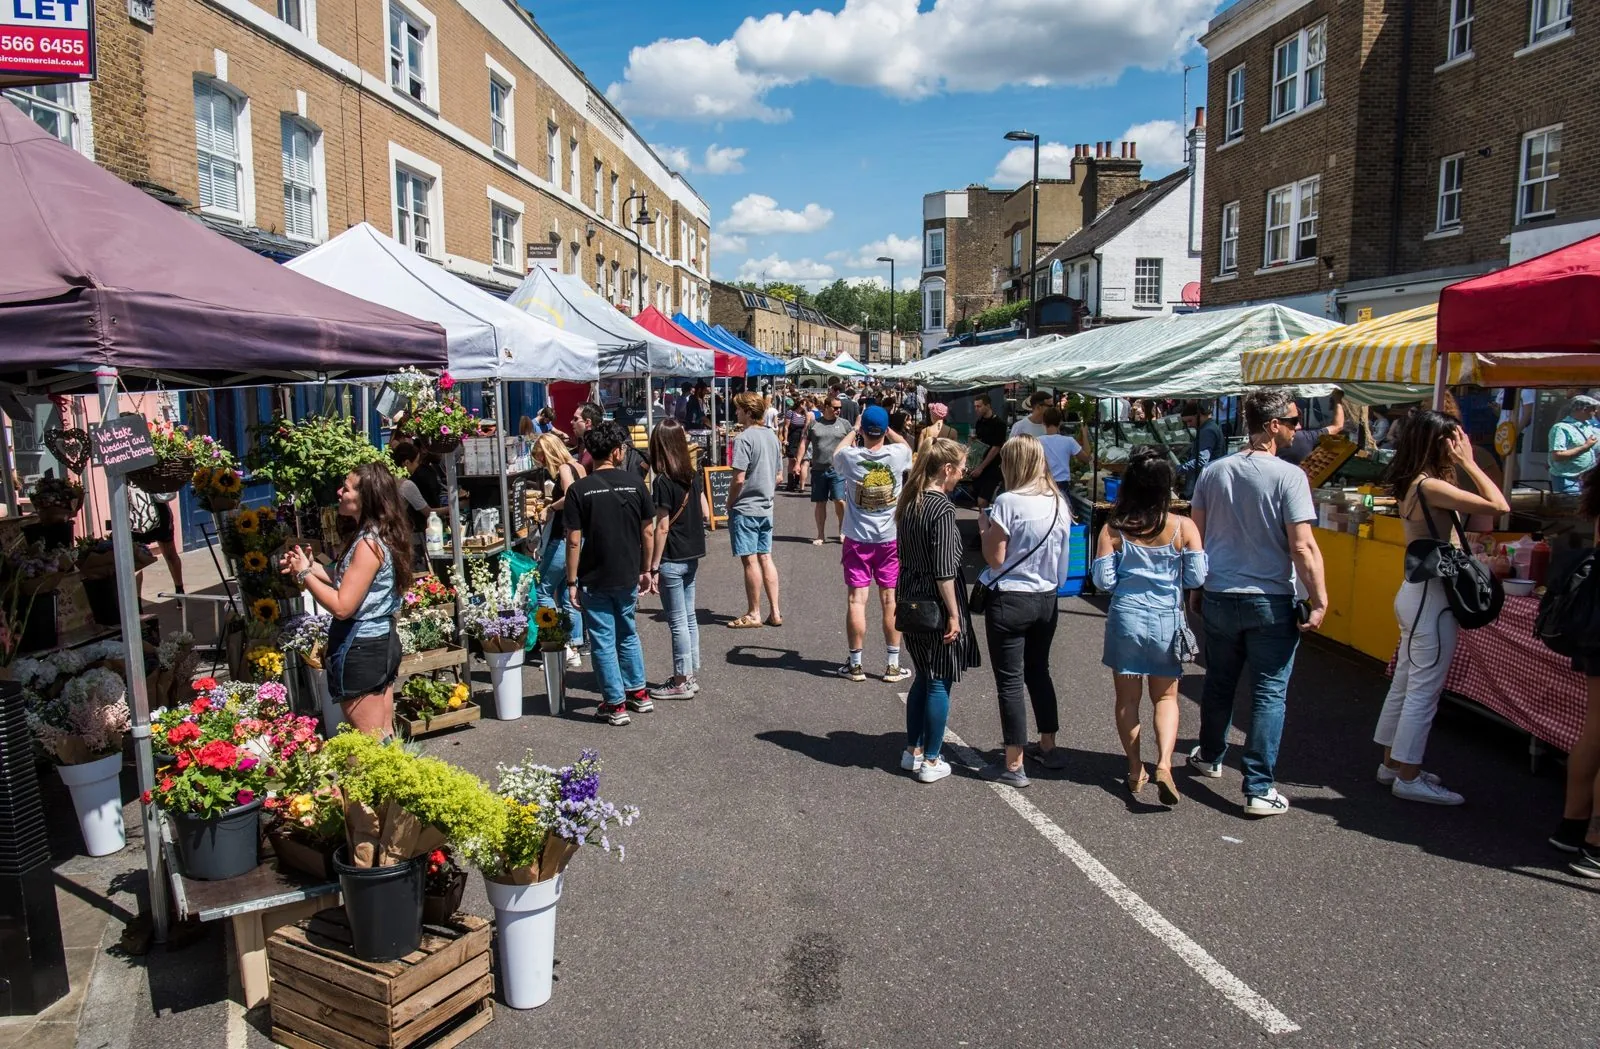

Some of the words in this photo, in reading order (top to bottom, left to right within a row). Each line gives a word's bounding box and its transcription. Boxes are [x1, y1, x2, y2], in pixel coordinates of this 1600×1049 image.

[13, 0, 79, 22] LET
[1, 35, 35, 52] 566
[40, 37, 84, 55] 6455
[96, 429, 113, 443] We
[112, 427, 133, 439] take
[132, 434, 146, 445] and
[104, 452, 131, 465] funeral
